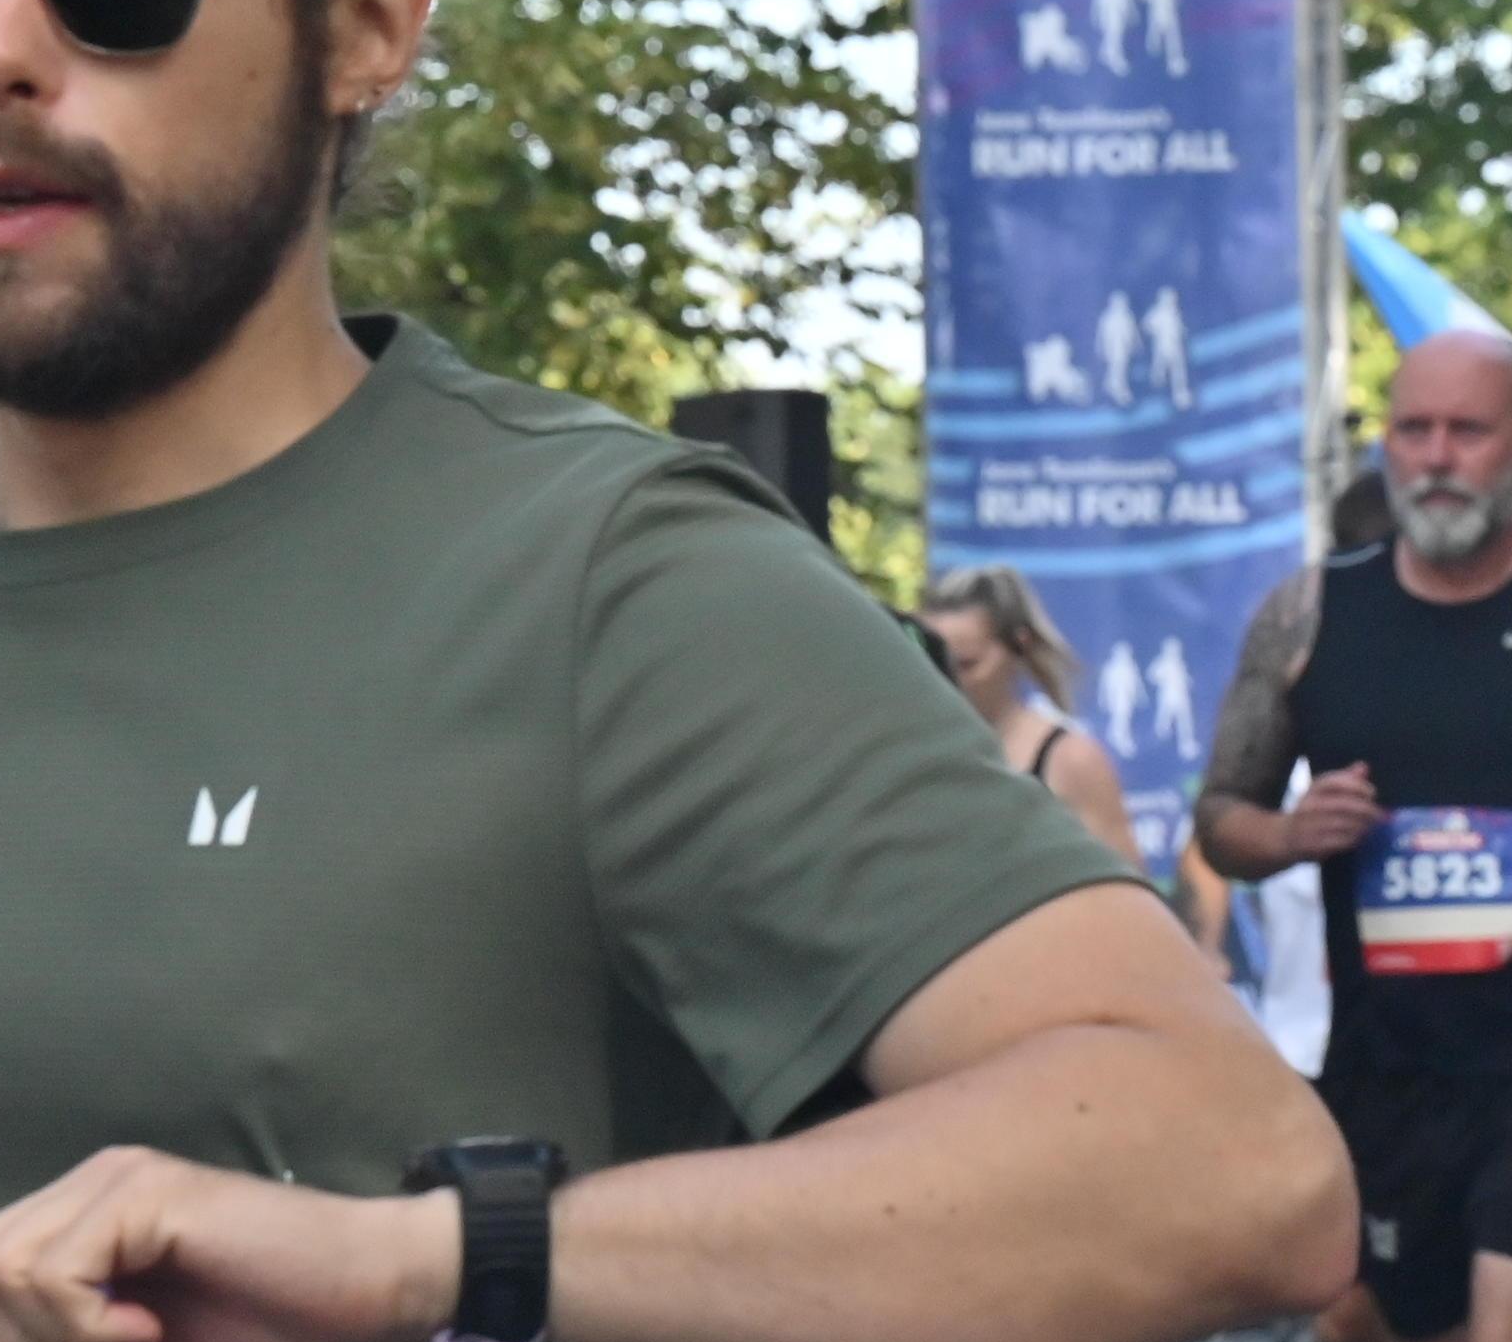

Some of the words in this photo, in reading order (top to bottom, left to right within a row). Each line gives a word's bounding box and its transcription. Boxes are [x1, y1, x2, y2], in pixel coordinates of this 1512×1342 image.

[971, 134, 1070, 178] RUN
[1072, 132, 1160, 177] FOR
[1161, 129, 1237, 172] ALL
[977, 485, 1071, 527] RUN
[1079, 483, 1161, 526] FOR
[1167, 481, 1248, 524] ALL
[1382, 853, 1503, 900] 5823
